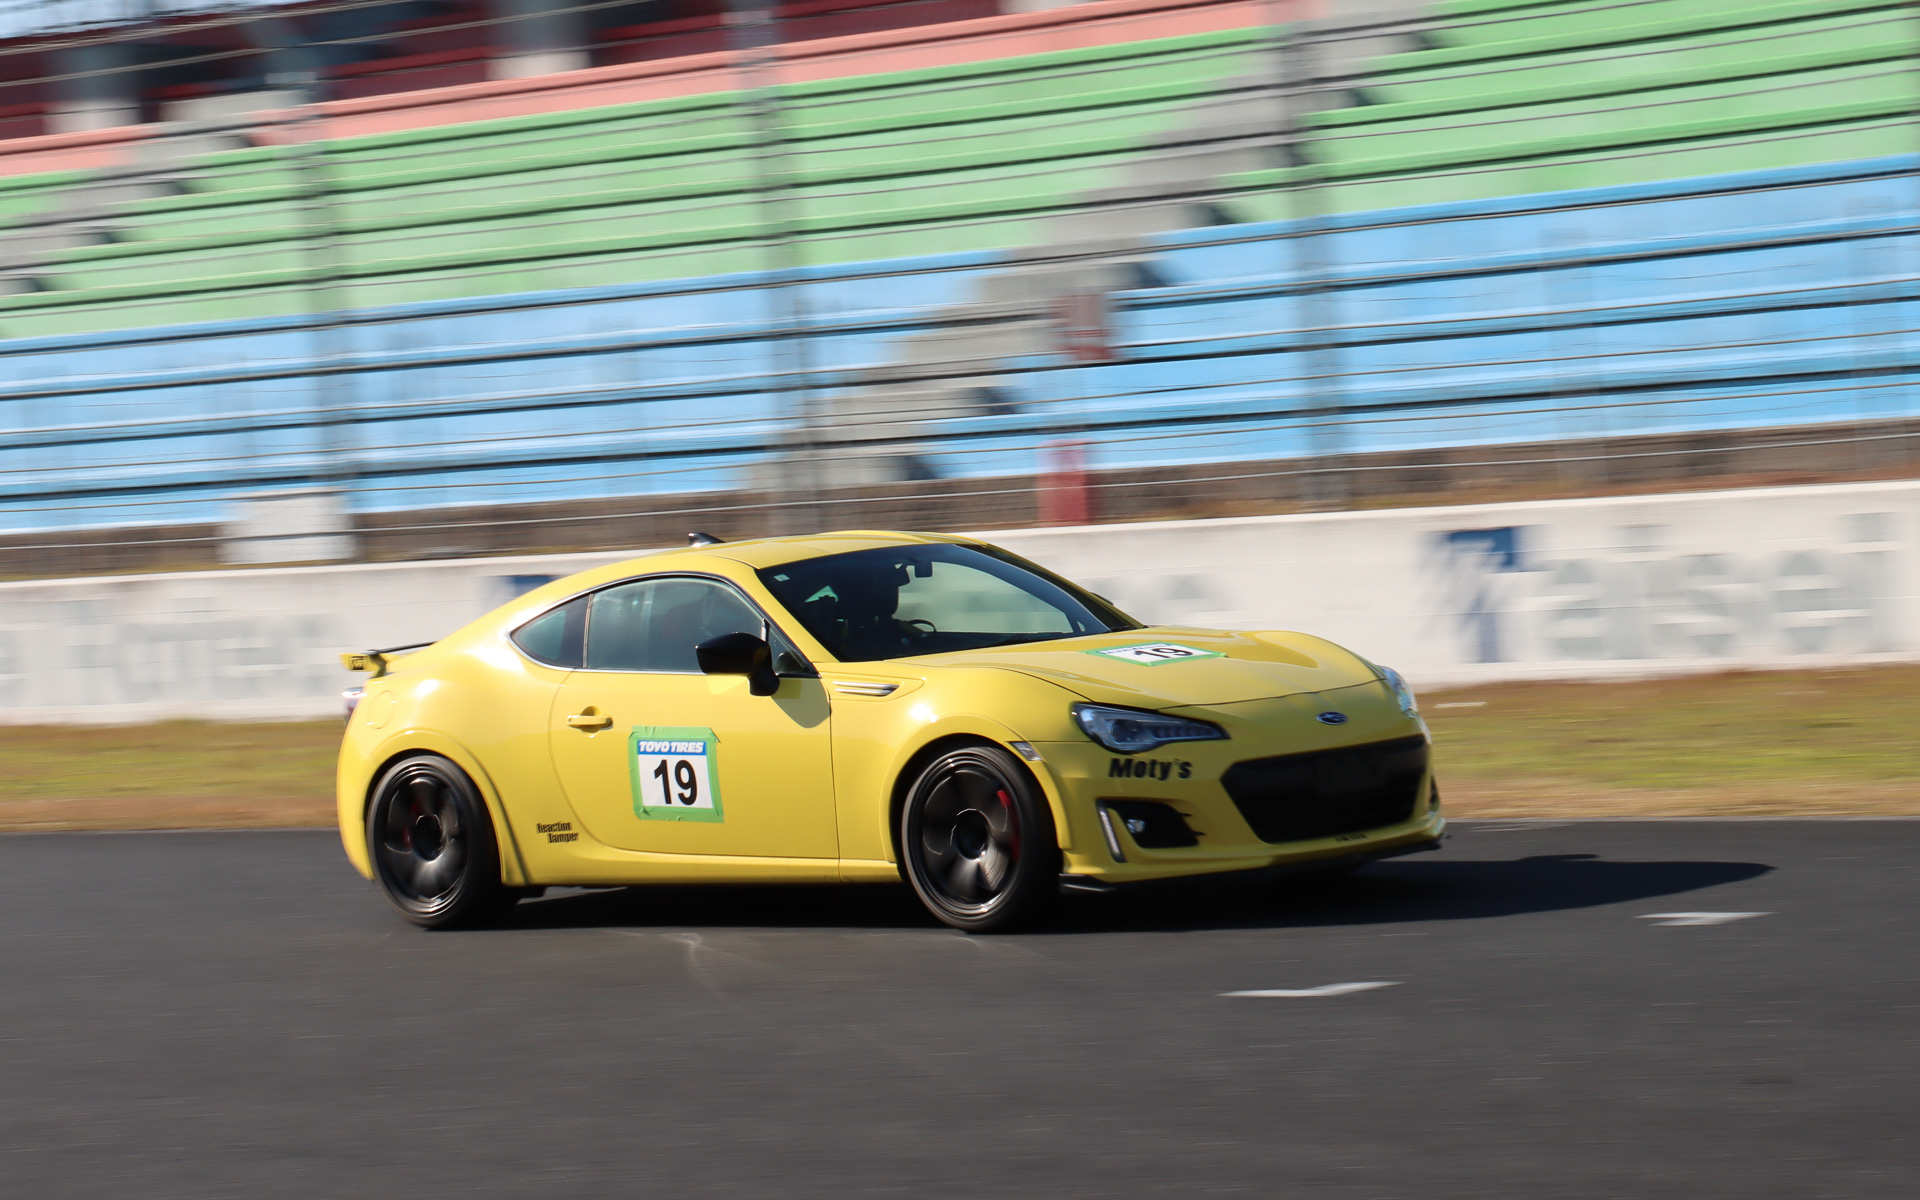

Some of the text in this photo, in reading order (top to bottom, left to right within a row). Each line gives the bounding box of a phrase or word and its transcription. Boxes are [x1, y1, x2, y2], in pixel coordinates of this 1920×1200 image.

[1134, 647, 1194, 659] 19
[639, 741, 704, 754] TOYO TIRES
[1108, 757, 1192, 781] Moty's
[653, 759, 698, 806] 19
